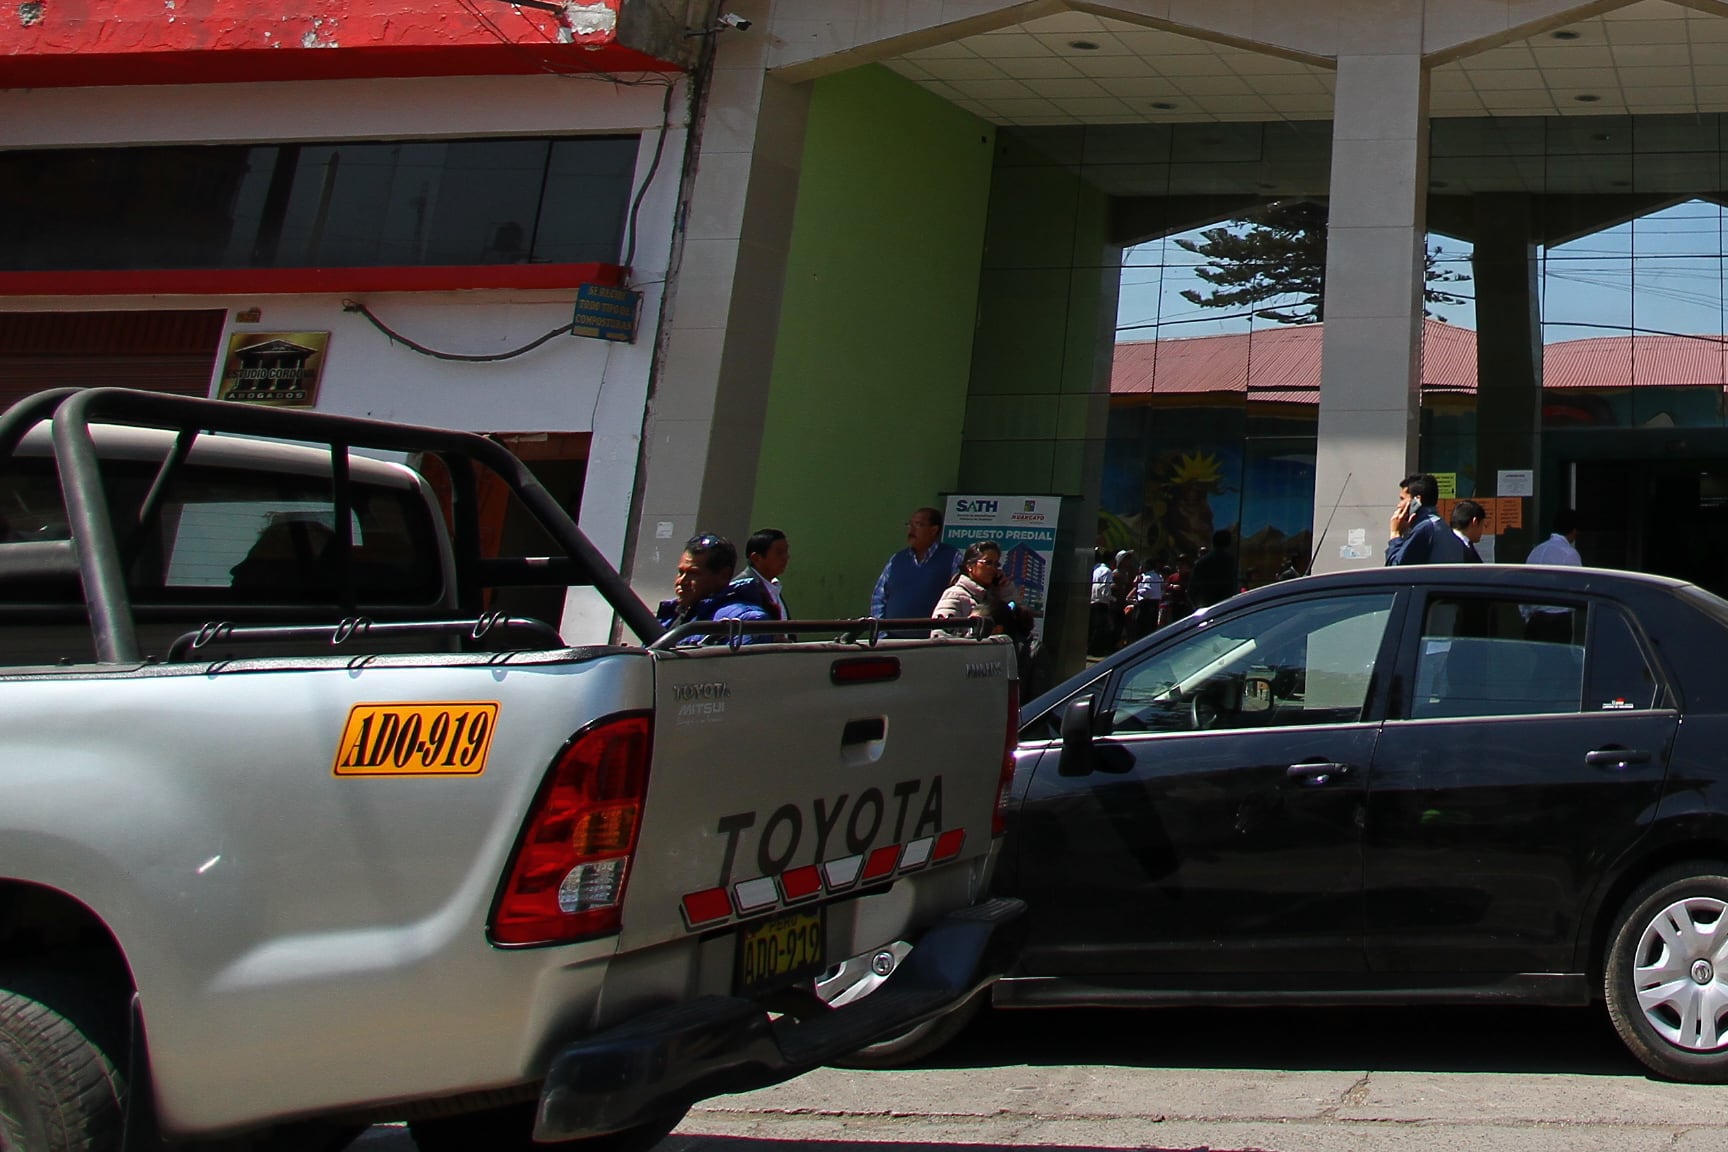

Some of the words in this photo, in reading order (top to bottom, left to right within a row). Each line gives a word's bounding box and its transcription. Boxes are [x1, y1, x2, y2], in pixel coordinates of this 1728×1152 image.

[268, 367, 315, 380] CORDO
[228, 392, 304, 400] ABOGADOS
[956, 500, 998, 512] SATH
[948, 529, 1003, 539] IMPUESTO
[1005, 530, 1053, 541] PREDIAL
[340, 711, 489, 768] ADO-919
[716, 775, 943, 886] TOYOTA
